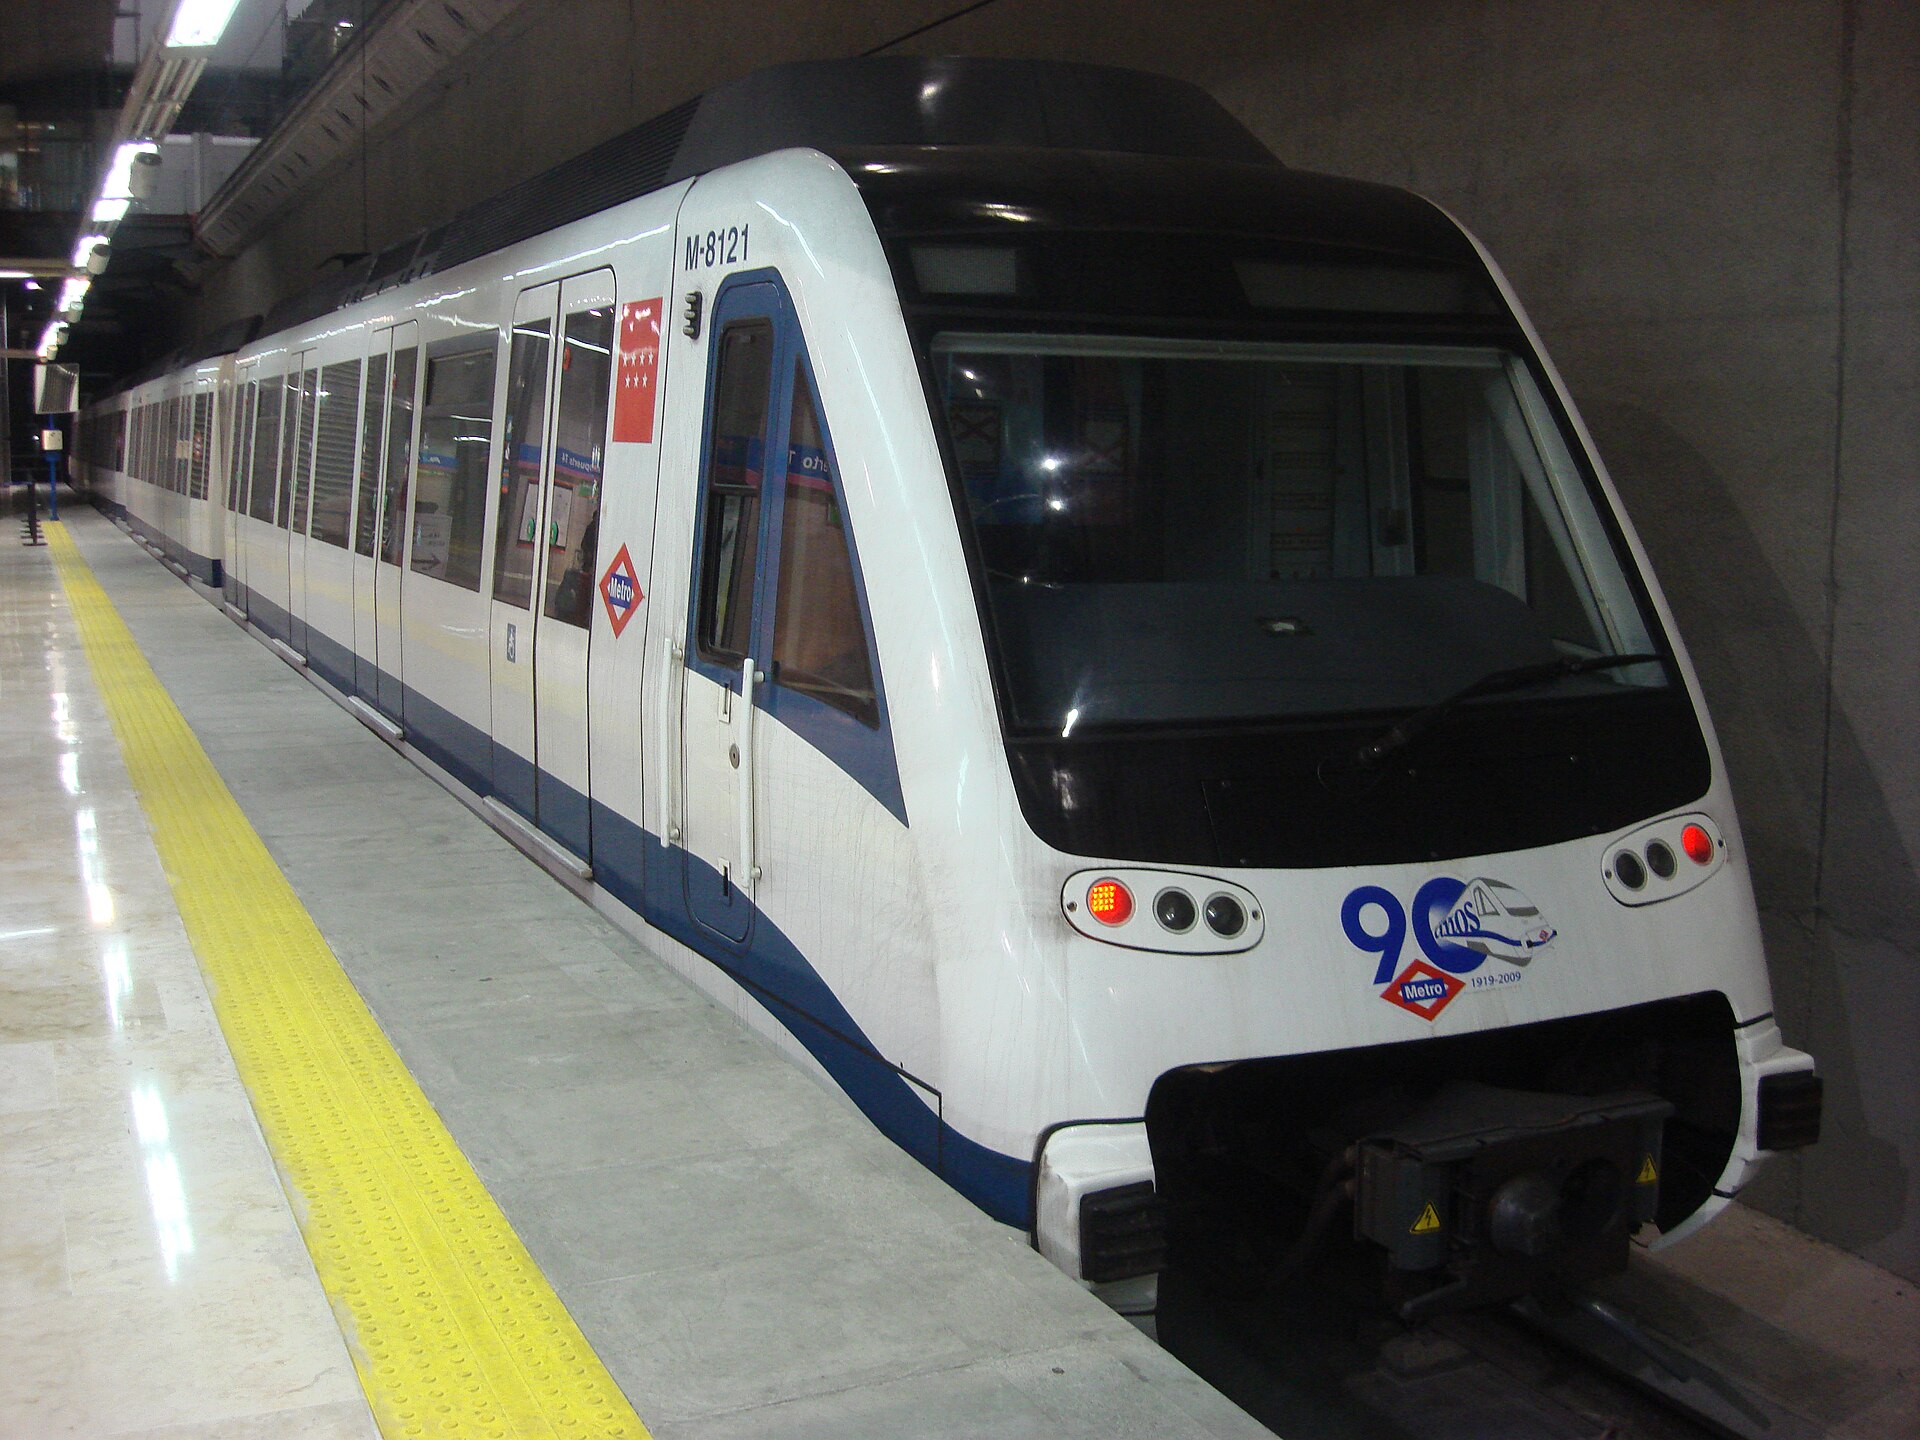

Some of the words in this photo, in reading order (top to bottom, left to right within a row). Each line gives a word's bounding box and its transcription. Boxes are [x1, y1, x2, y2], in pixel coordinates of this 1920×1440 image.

[684, 223, 749, 271] M-8121
[609, 577, 633, 602] Metro
[1340, 877, 1489, 986] 90
[1403, 982, 1443, 1000] Metro
[1471, 971, 1522, 988] 1919-2009
